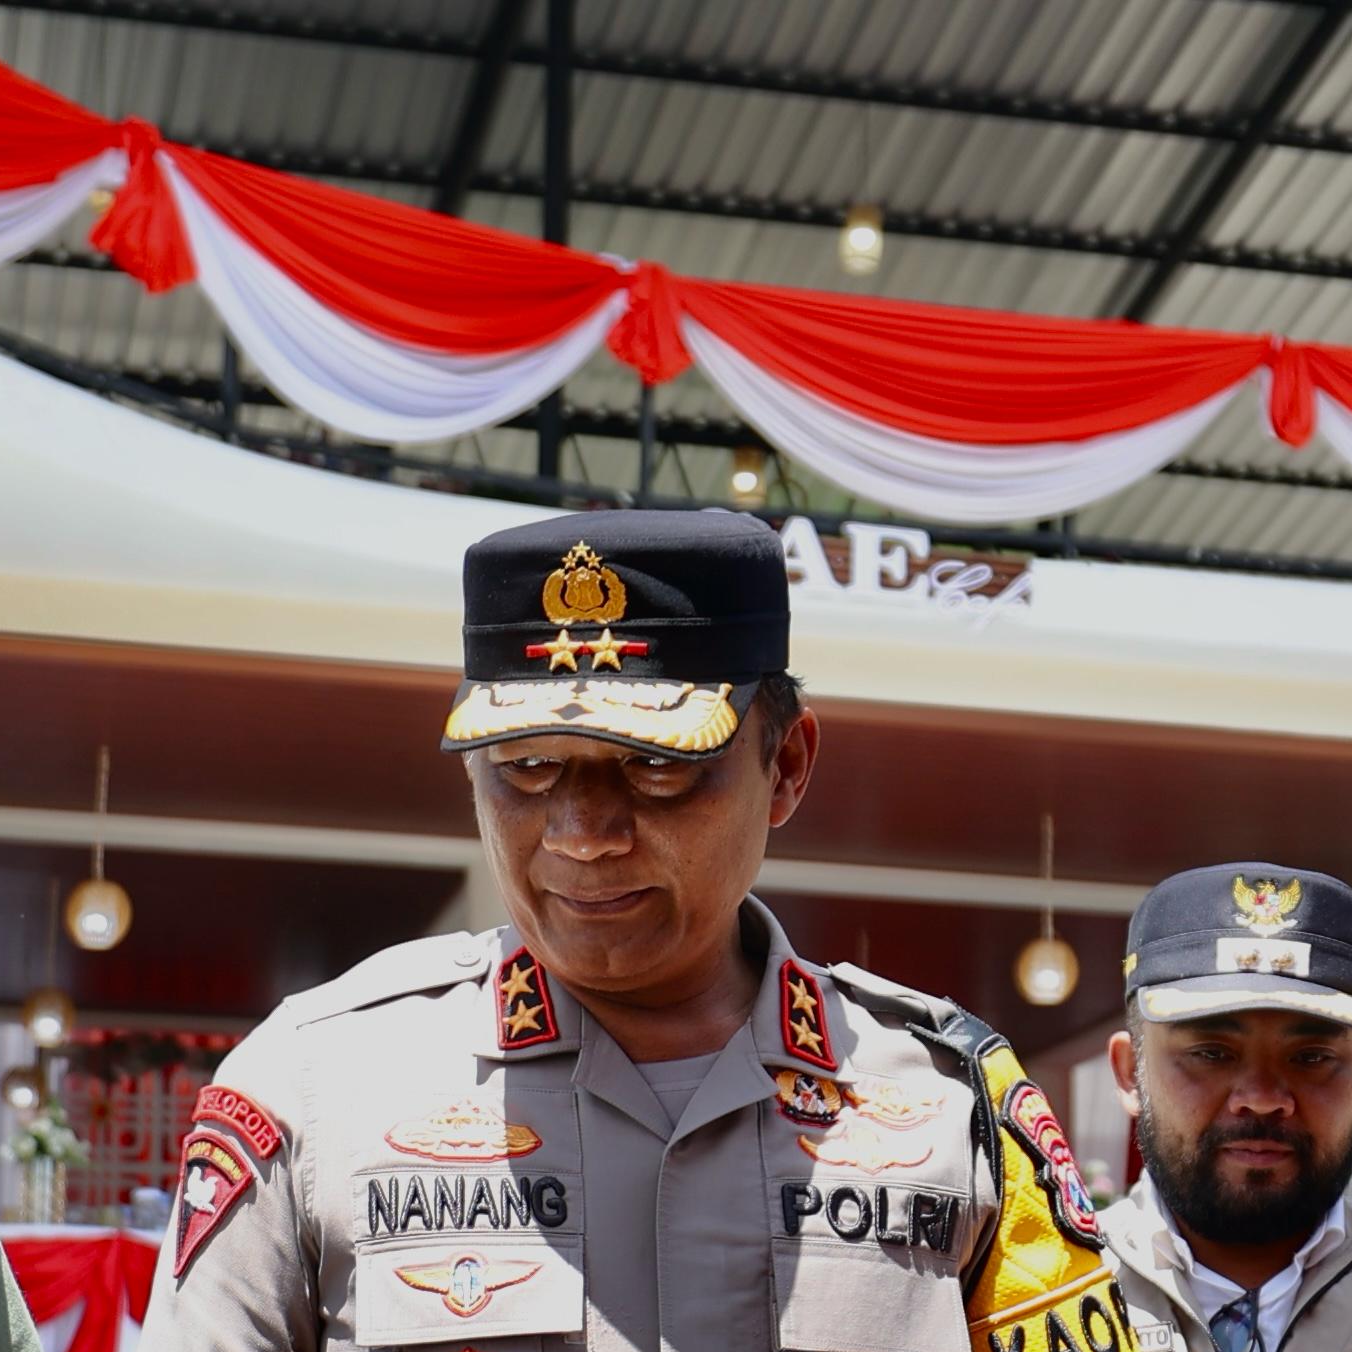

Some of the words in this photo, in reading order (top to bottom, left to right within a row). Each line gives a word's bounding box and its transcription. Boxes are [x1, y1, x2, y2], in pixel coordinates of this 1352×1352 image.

[781, 516, 932, 593] AE
[367, 1175, 568, 1236] NANANG
[781, 1182, 960, 1252] POLRI
